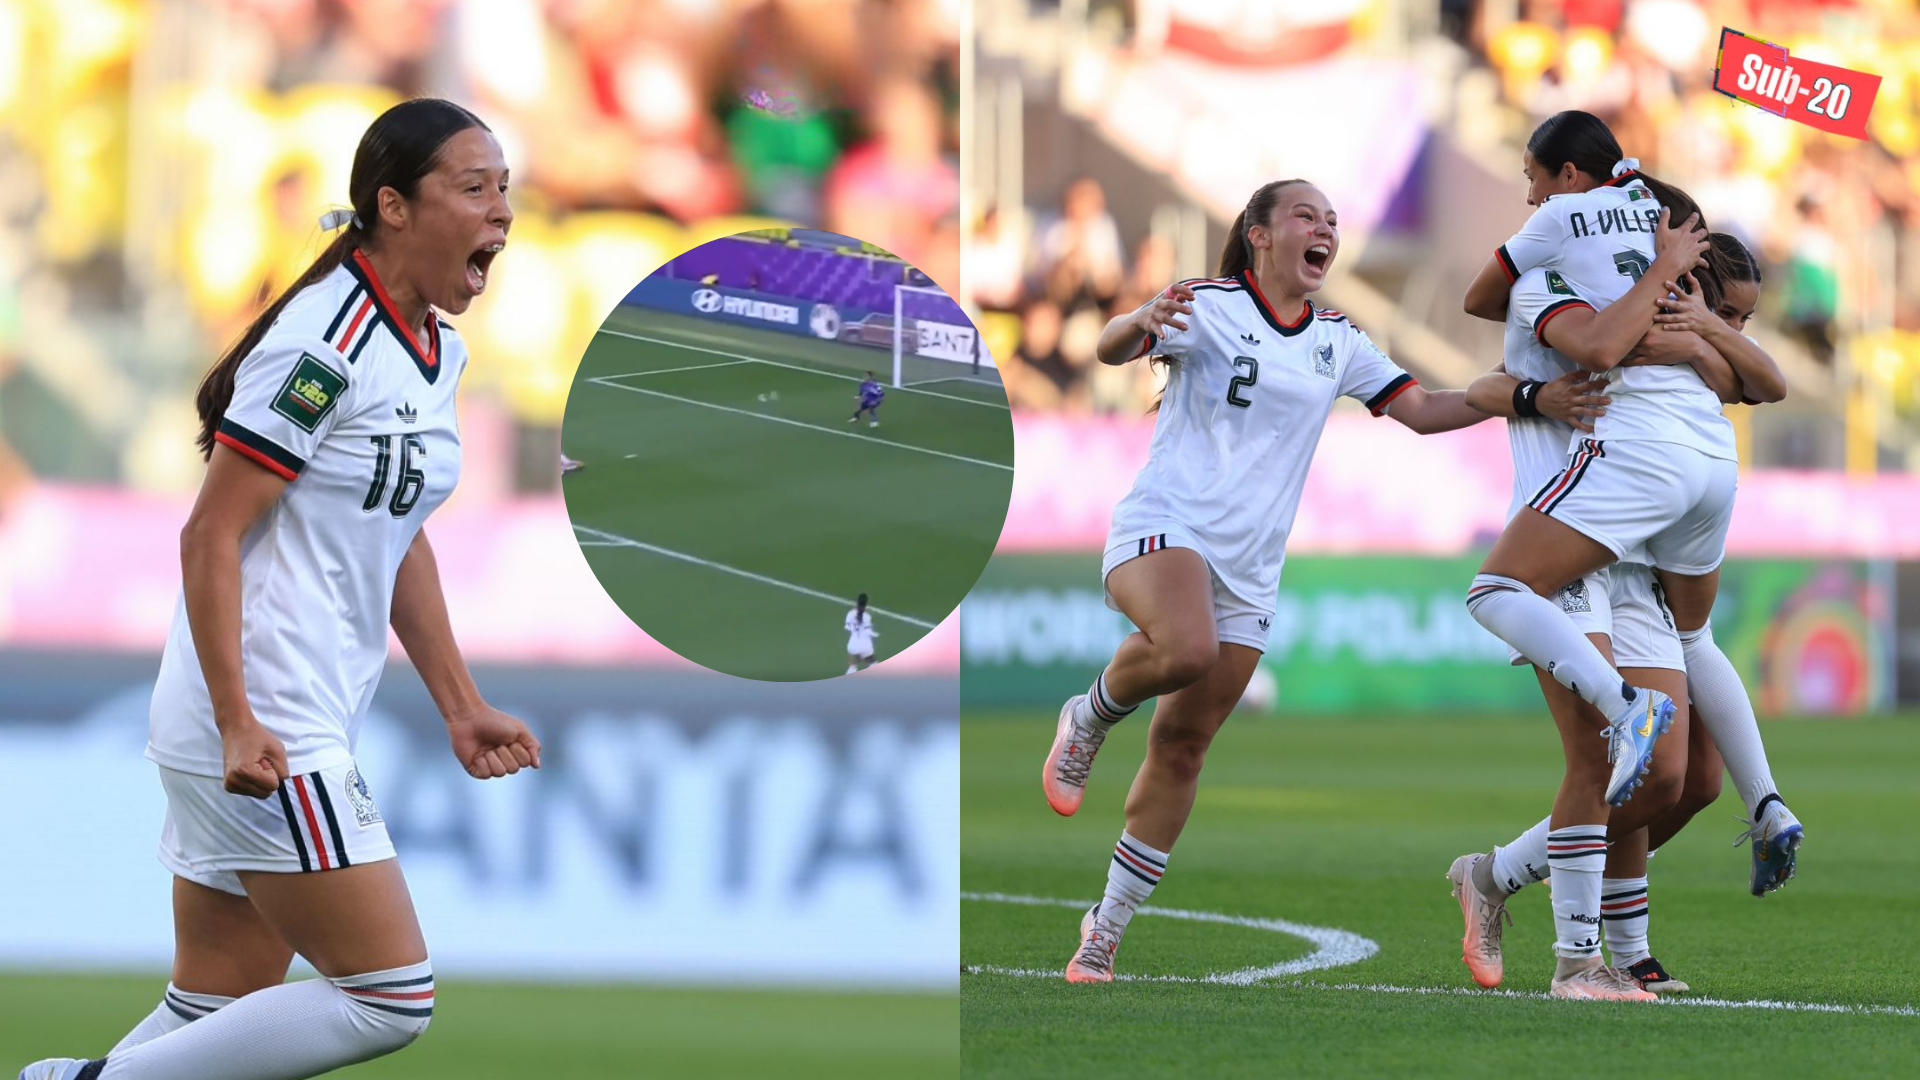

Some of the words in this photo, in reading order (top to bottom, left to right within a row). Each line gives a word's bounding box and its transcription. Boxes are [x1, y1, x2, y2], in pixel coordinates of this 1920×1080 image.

[723, 295, 799, 325] HYUNDAI
[919, 326, 978, 355] SANT
[1226, 355, 1259, 409] 2
[363, 434, 426, 519] 16
